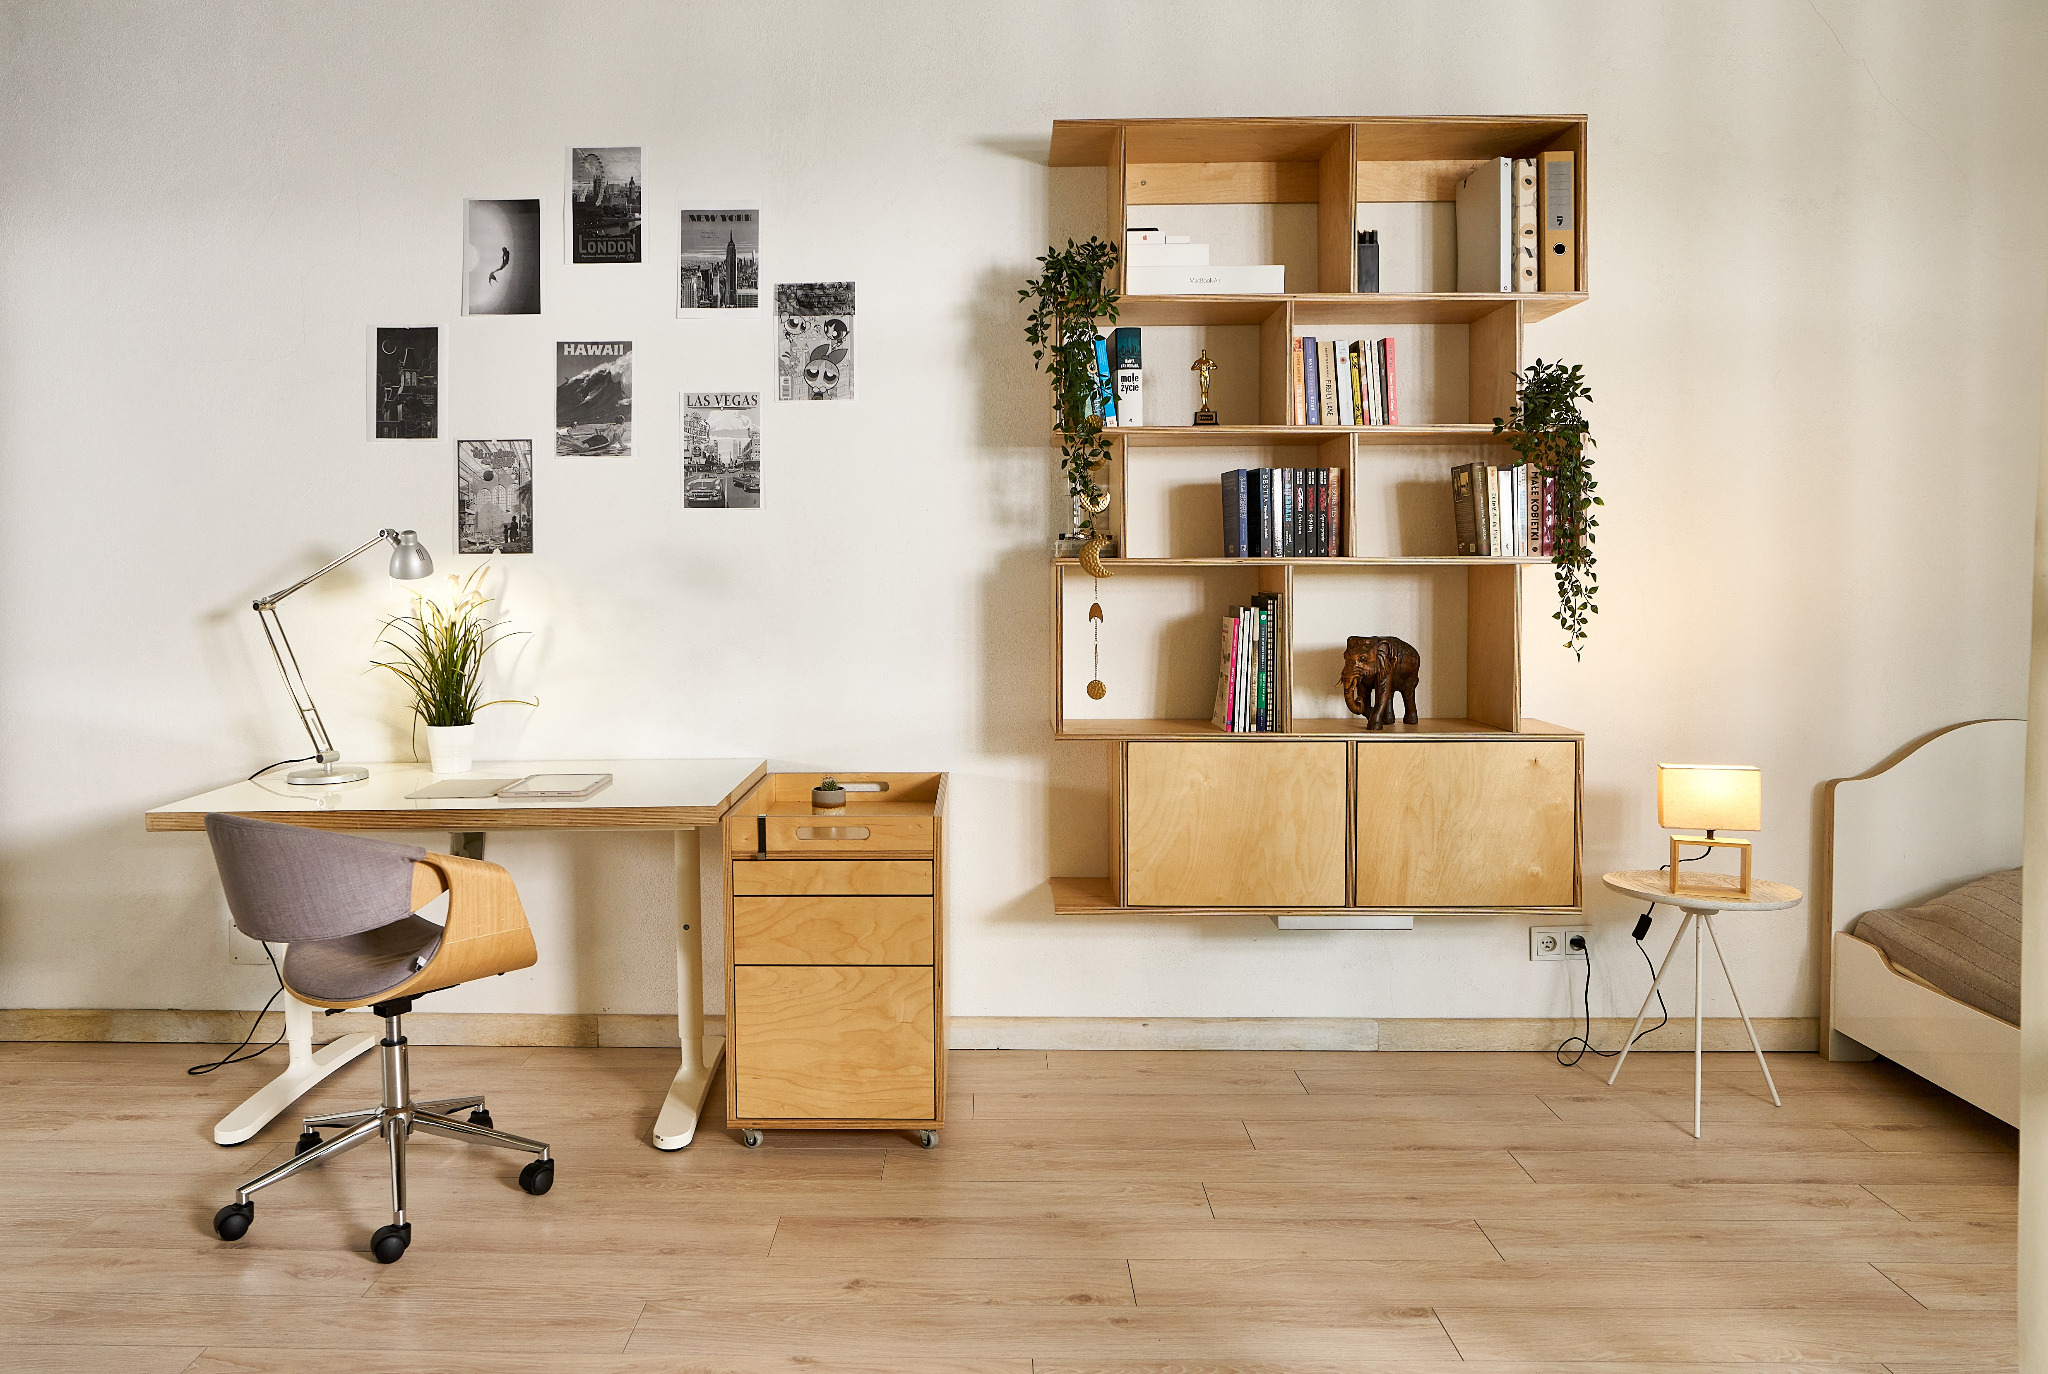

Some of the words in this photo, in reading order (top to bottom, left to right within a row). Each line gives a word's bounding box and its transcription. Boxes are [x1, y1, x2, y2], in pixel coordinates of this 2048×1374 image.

[688, 214, 717, 222] NEW
[720, 214, 752, 222] YORK
[578, 234, 636, 253] LONDON
[563, 343, 624, 356] HAWAII
[1120, 382, 1139, 394] życie
[687, 394, 711, 406] LAS
[714, 394, 758, 406] VEGAS
[1531, 471, 1539, 496] MAŁE
[1531, 498, 1539, 541] KOBIETKI
